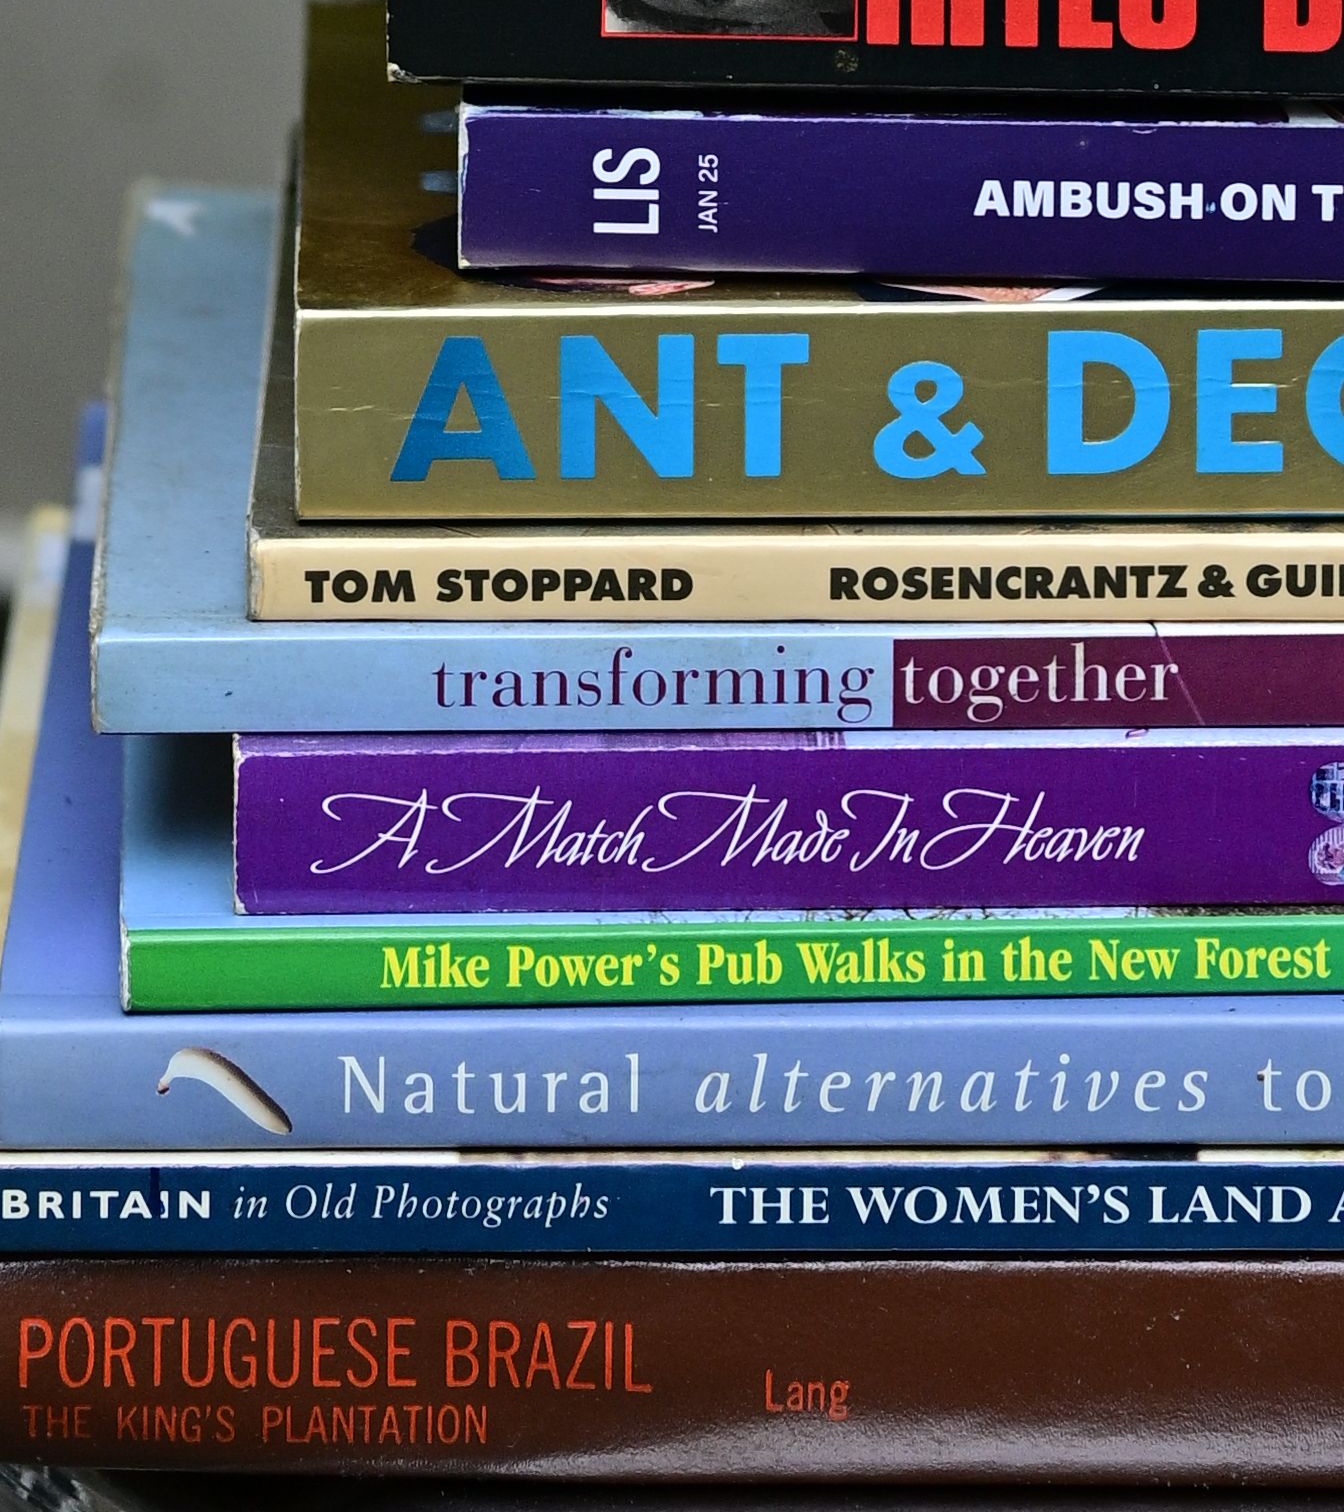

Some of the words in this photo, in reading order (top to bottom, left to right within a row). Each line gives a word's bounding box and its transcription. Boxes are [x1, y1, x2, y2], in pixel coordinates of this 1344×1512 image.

[592, 146, 661, 235] LIS
[697, 153, 720, 183] 25
[697, 189, 720, 234] JAN
[973, 179, 1205, 221] AMBUSH
[1219, 181, 1297, 222] ON
[389, 333, 811, 483] ANT
[872, 360, 987, 479] &
[304, 568, 417, 604] TOM
[435, 567, 694, 604] STOPPARD
[829, 564, 1189, 602] ROSENCRANTZ
[1197, 564, 1236, 600] &
[432, 645, 876, 724] transforming
[898, 642, 1180, 724] together
[309, 787, 438, 875] A
[425, 784, 654, 875] Match
[640, 782, 851, 874] Made
[841, 788, 917, 873] In
[920, 787, 1146, 871] Heaven
[380, 944, 490, 990] Mike
[696, 939, 783, 986] Pub
[796, 937, 927, 984] Walks
[942, 937, 986, 983] in
[1001, 935, 1074, 983] the
[1088, 937, 1181, 982] New
[1194, 936, 1332, 981] Forest
[337, 1052, 640, 1115] Natural
[695, 1051, 1210, 1114] alternatives
[1261, 1058, 1333, 1114] to
[1, 1189, 211, 1221] BRITAIN
[233, 1185, 268, 1220] in
[285, 1182, 356, 1221] Old
[372, 1183, 610, 1229] Photographs
[710, 1185, 831, 1225] THE
[1147, 1185, 1312, 1225] LAND
[18, 1316, 419, 1390] PORTUGUESE
[445, 1320, 654, 1395] BRAZIL
[764, 1367, 851, 1422] Lang
[22, 1404, 93, 1441] THE
[117, 1404, 238, 1443] KING'S
[261, 1404, 489, 1445] PLANTATION
